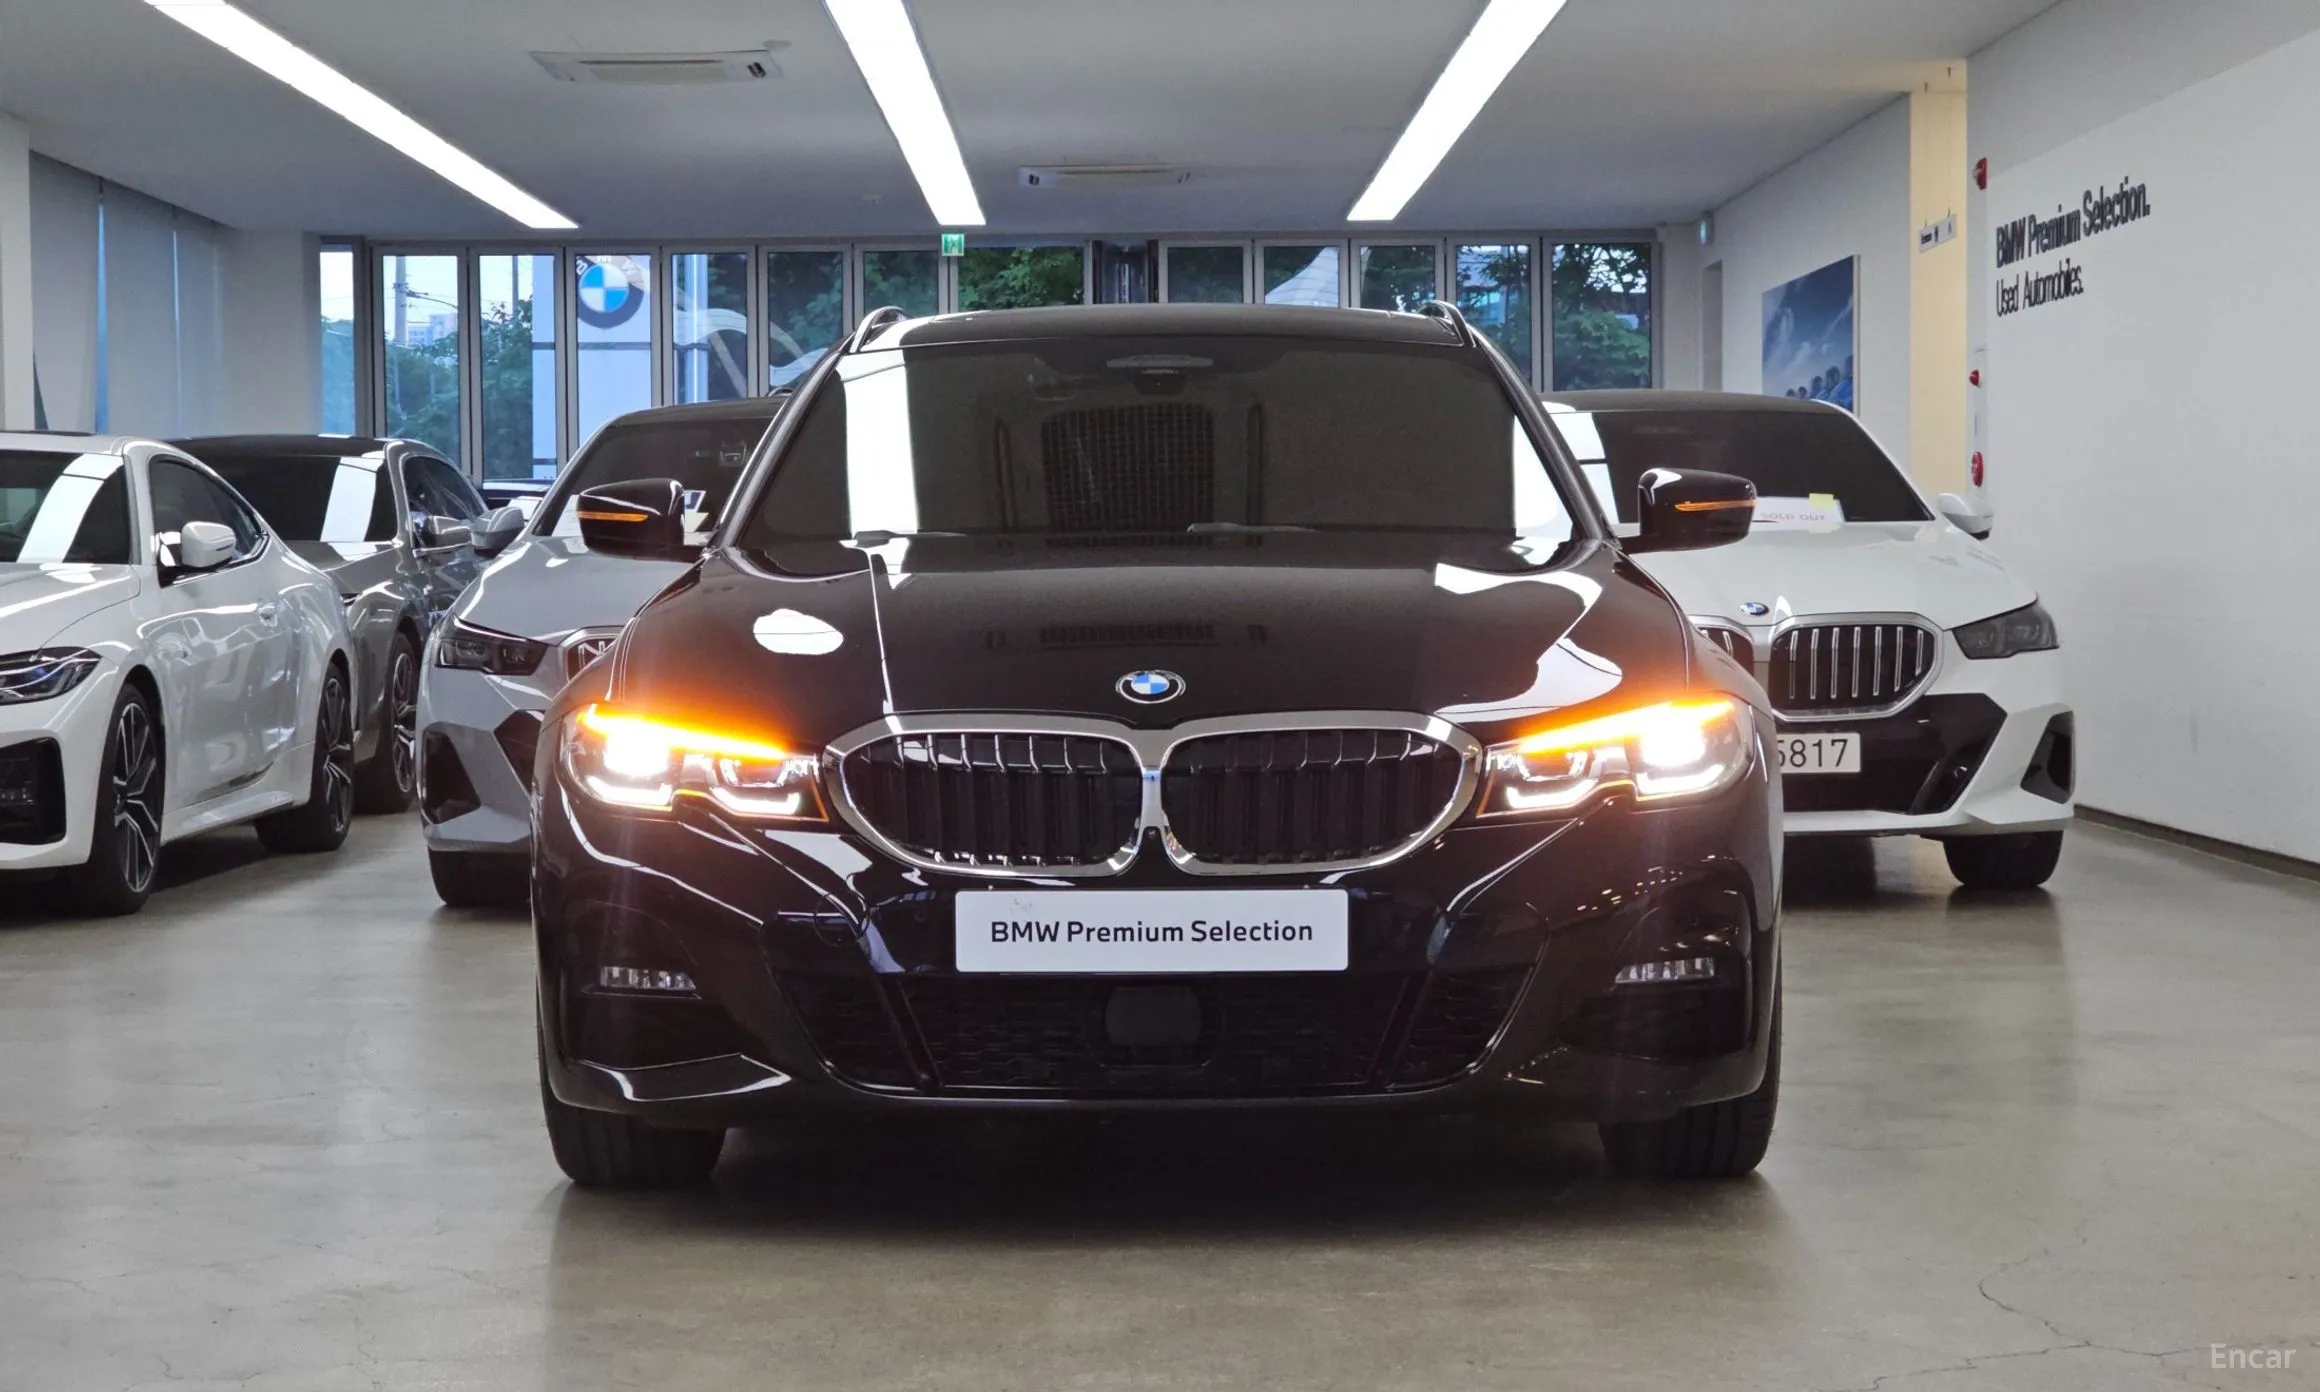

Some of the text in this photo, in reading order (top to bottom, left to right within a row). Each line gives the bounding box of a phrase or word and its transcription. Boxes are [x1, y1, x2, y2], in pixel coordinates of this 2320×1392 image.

[1996, 176, 2150, 268] BMW Premium Selection.
[1996, 273, 2019, 317] Used
[1760, 512, 1825, 521] SOLD OUT
[991, 919, 1313, 943] BMW Premium Selection
